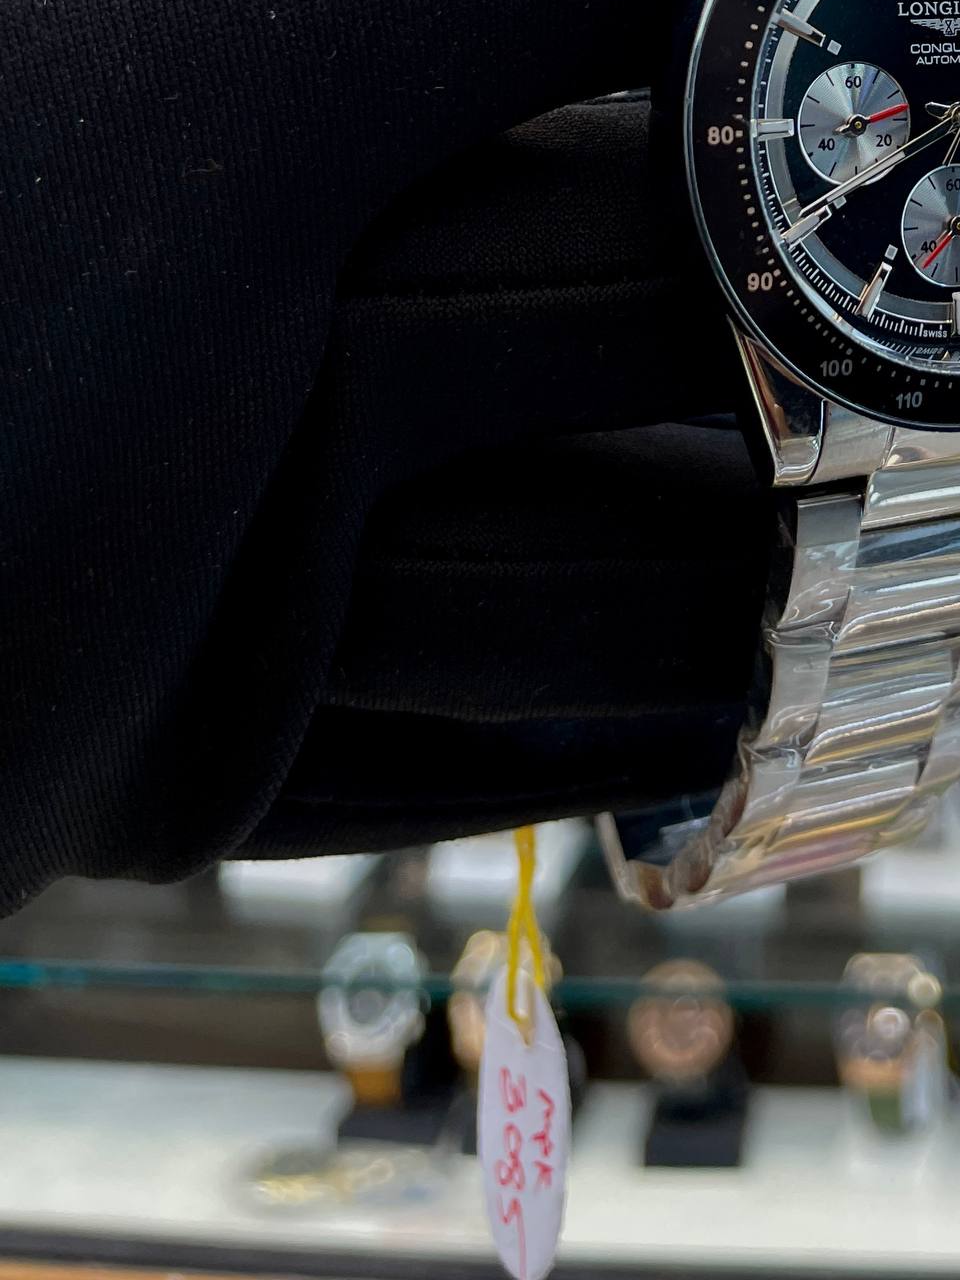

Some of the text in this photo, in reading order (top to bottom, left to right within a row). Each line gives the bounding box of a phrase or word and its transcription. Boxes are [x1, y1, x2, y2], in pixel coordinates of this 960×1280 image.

[845, 75, 862, 89] 60
[707, 126, 733, 145] 80
[875, 133, 893, 148] 20
[818, 138, 836, 151] 40
[920, 239, 937, 254] 40
[747, 272, 773, 291] 90
[922, 329, 948, 338] SWISS
[820, 359, 853, 378] 100
[895, 391, 923, 409] 110
